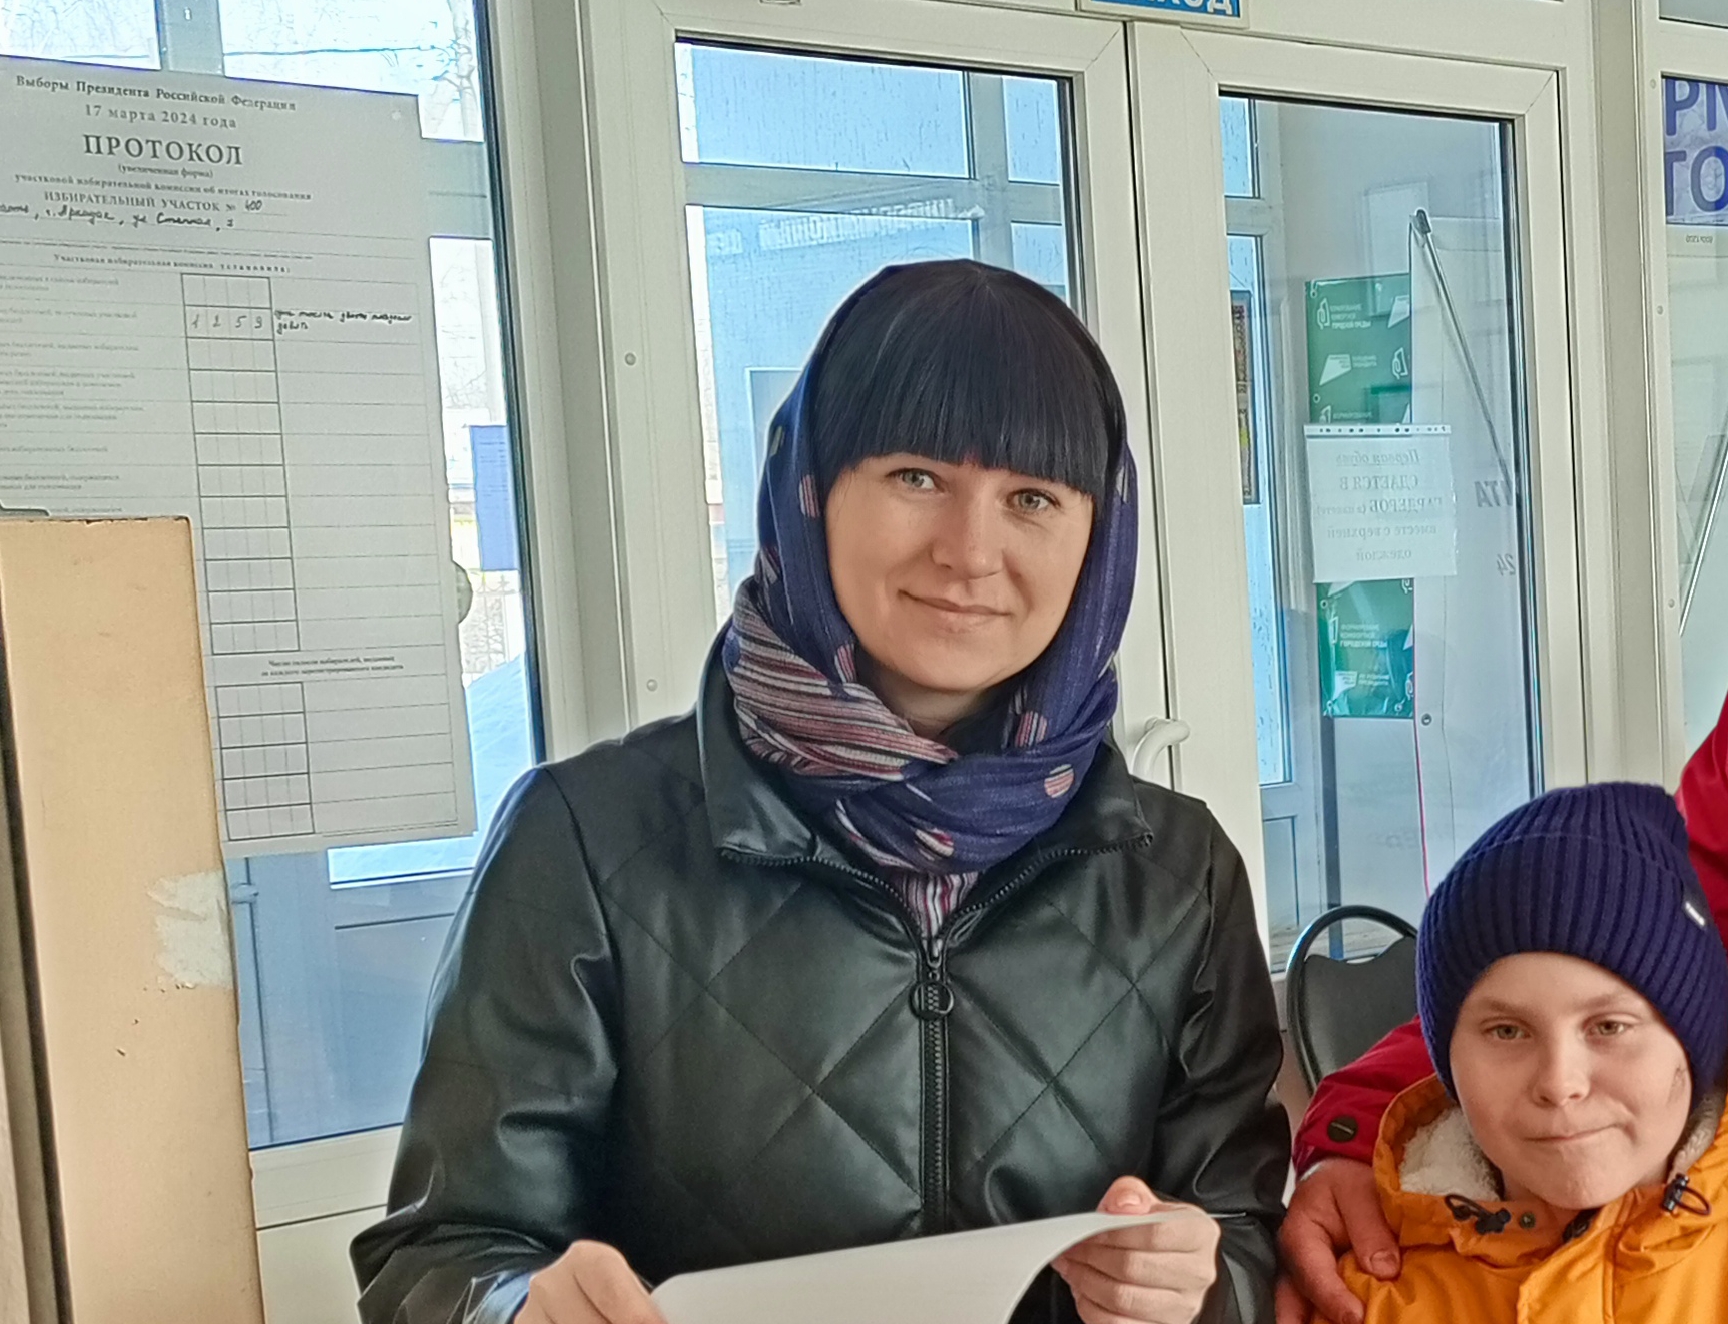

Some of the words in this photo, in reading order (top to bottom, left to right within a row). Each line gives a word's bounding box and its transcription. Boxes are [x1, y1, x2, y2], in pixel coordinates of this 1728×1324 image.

[16, 76, 69, 91] Выборы
[76, 81, 150, 98] Президента
[156, 88, 225, 105] Российской
[231, 95, 296, 112] Федерации
[85, 104, 102, 117] 17
[108, 109, 156, 123] марта
[161, 111, 197, 125] 2024
[202, 117, 237, 129] года
[83, 134, 243, 166] ПРОТОКОЛ
[44, 190, 156, 208] ИЗБИРАТЕЛЬНЫЙ
[161, 197, 220, 212] УЧАСТОК
